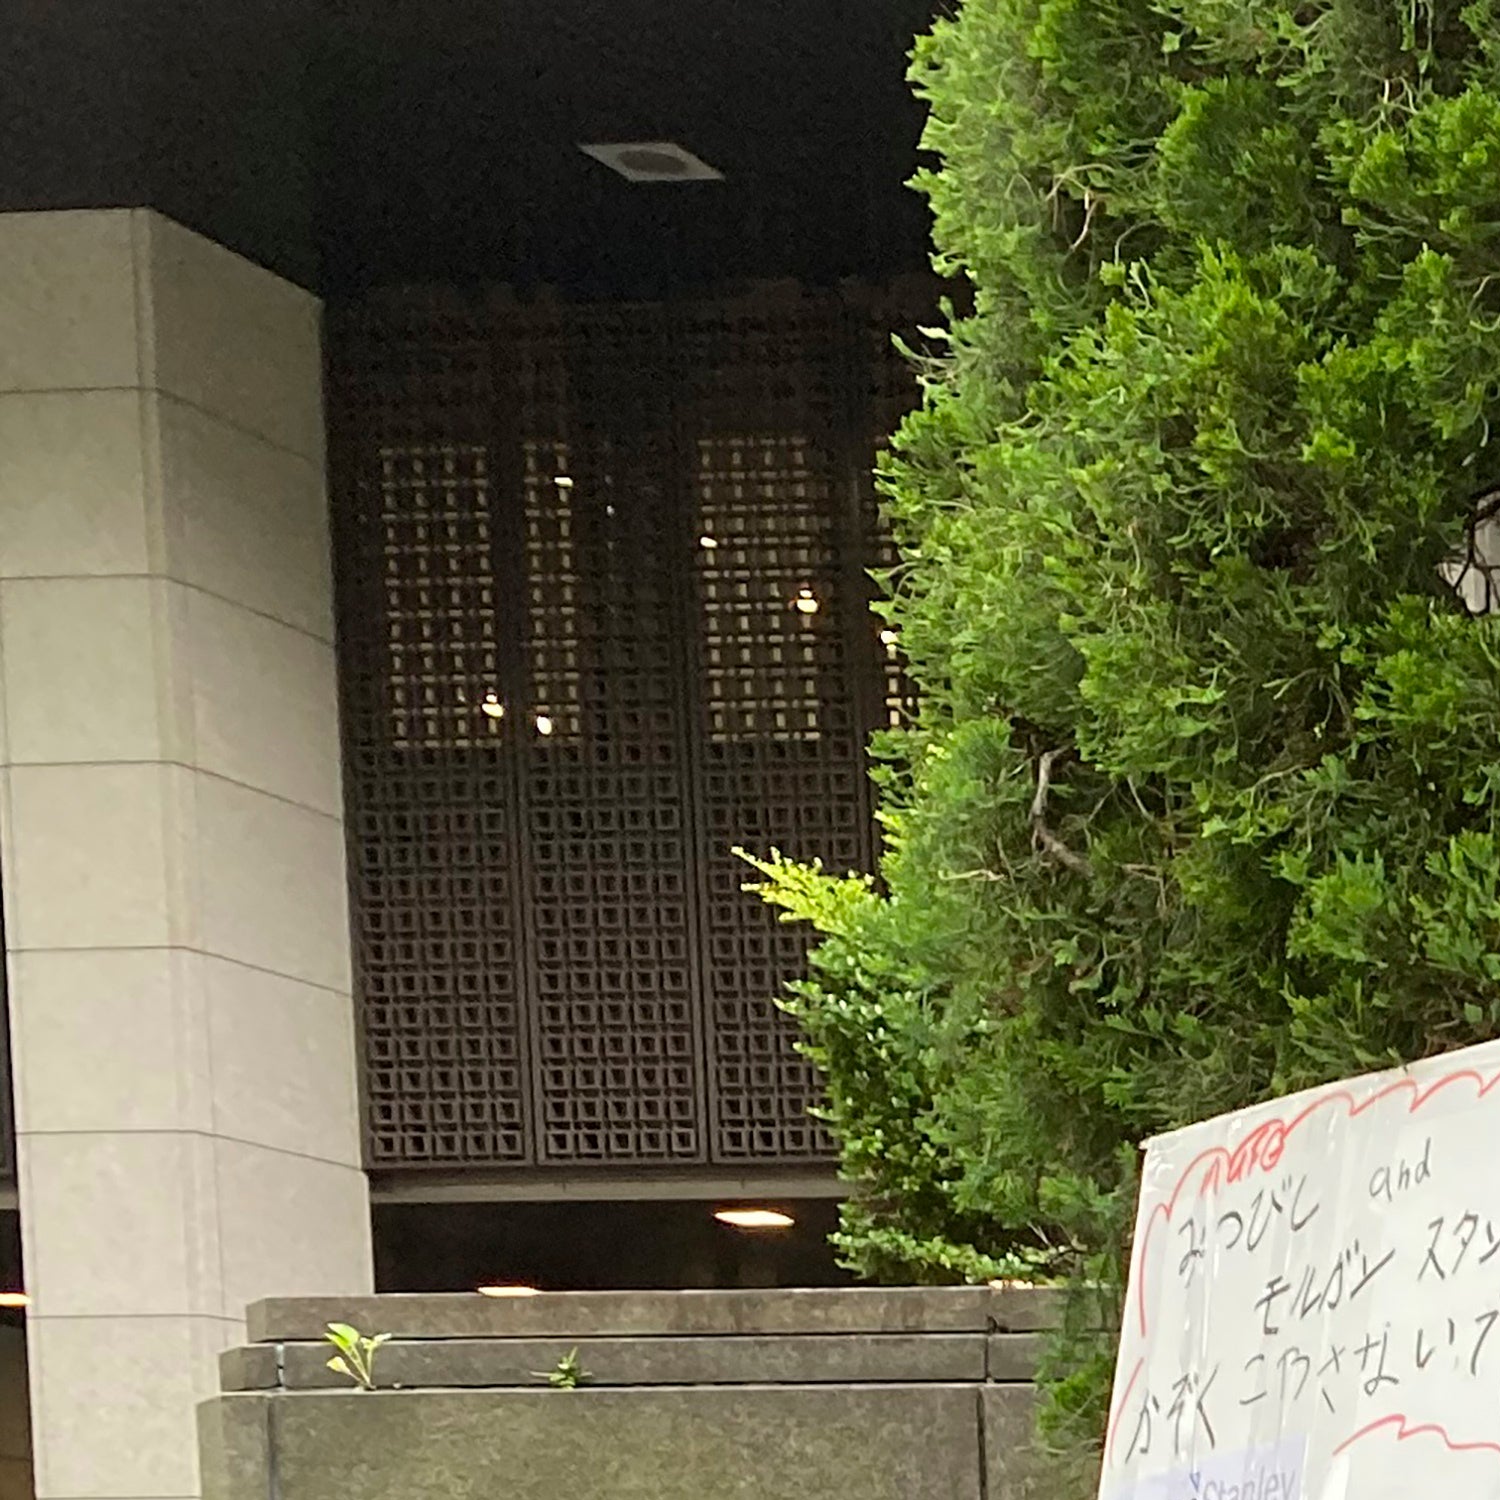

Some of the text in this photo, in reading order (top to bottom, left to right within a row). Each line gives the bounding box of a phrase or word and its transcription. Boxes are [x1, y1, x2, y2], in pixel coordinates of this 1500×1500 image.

[1369, 1137, 1432, 1201] and
[1254, 1240, 1396, 1336] モルガン
